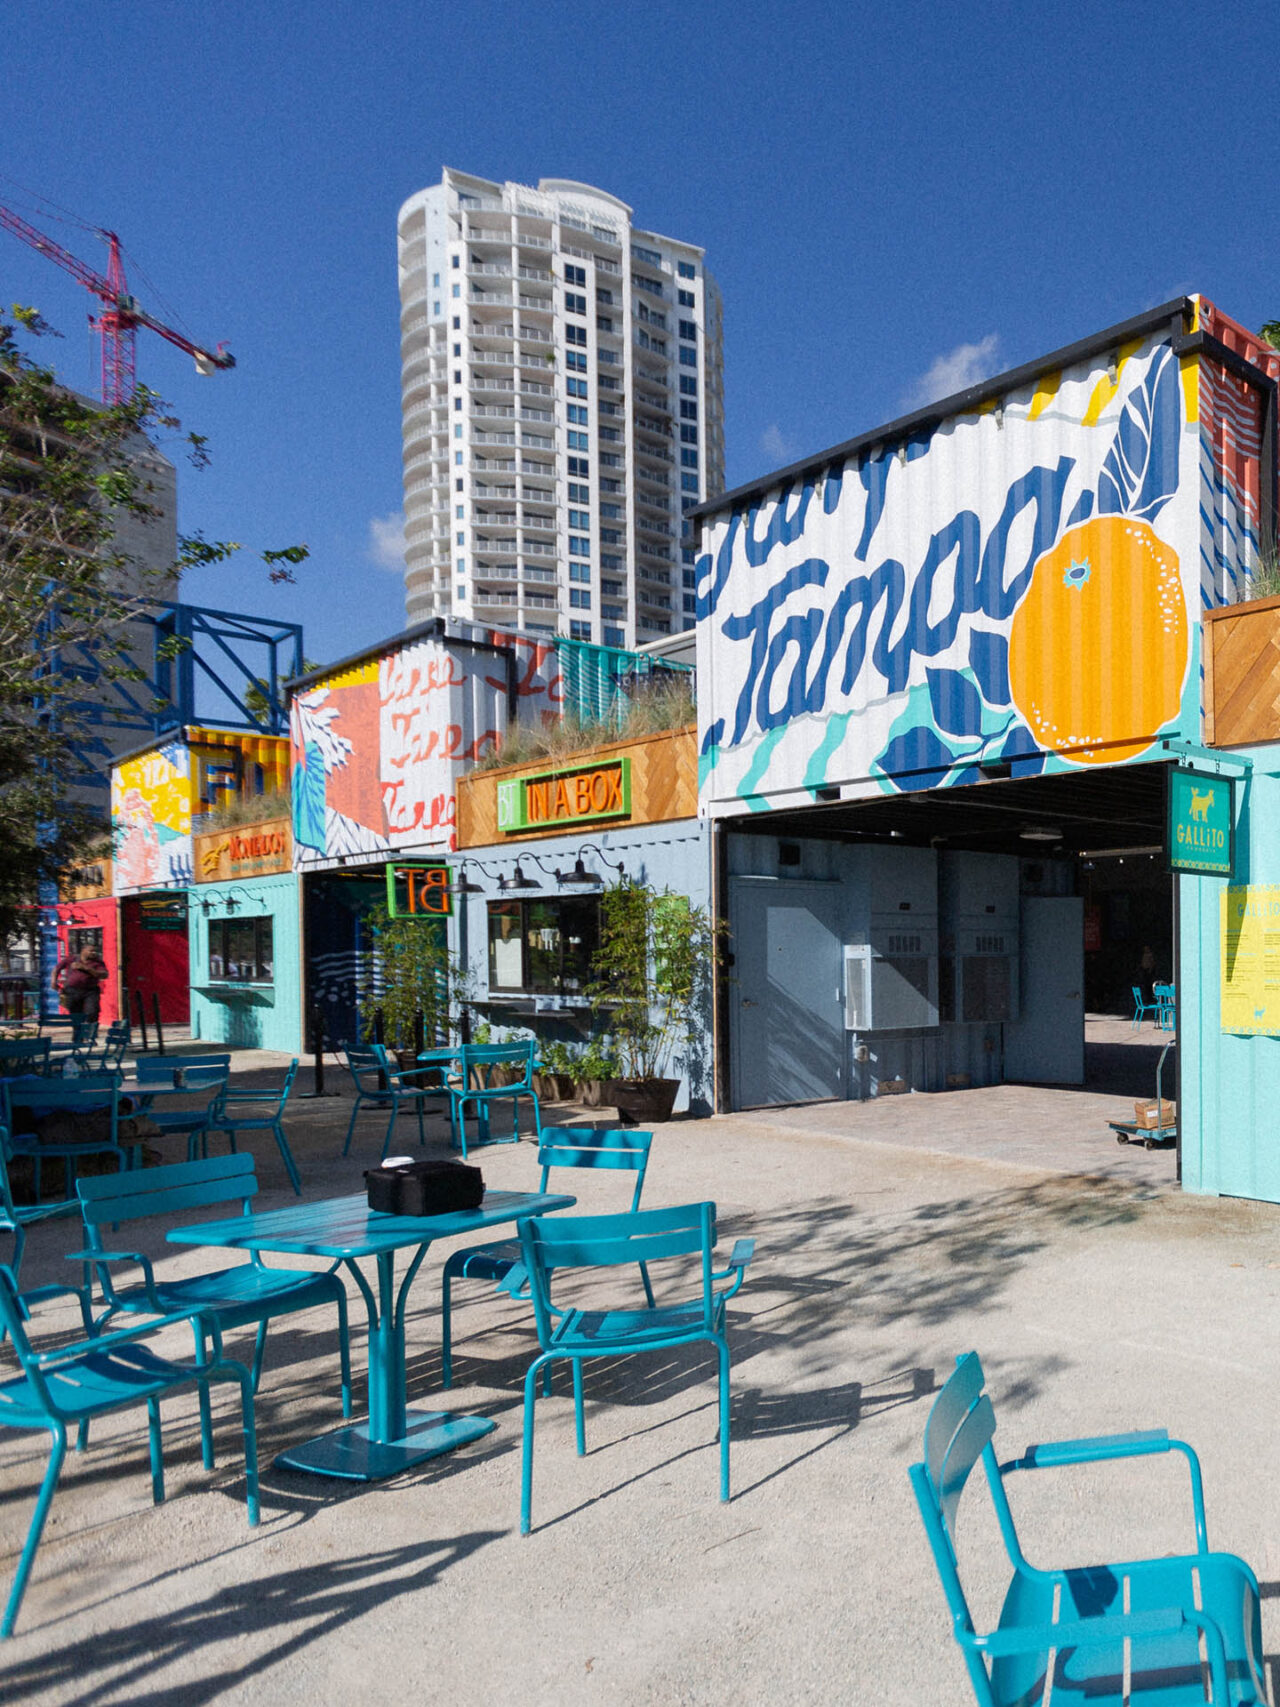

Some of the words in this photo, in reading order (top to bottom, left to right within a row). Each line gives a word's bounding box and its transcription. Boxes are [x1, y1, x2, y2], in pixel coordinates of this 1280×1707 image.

[721, 455, 1076, 748] Tampa
[527, 782, 550, 822] IN
[555, 779, 570, 816] A
[576, 767, 622, 814] BOX
